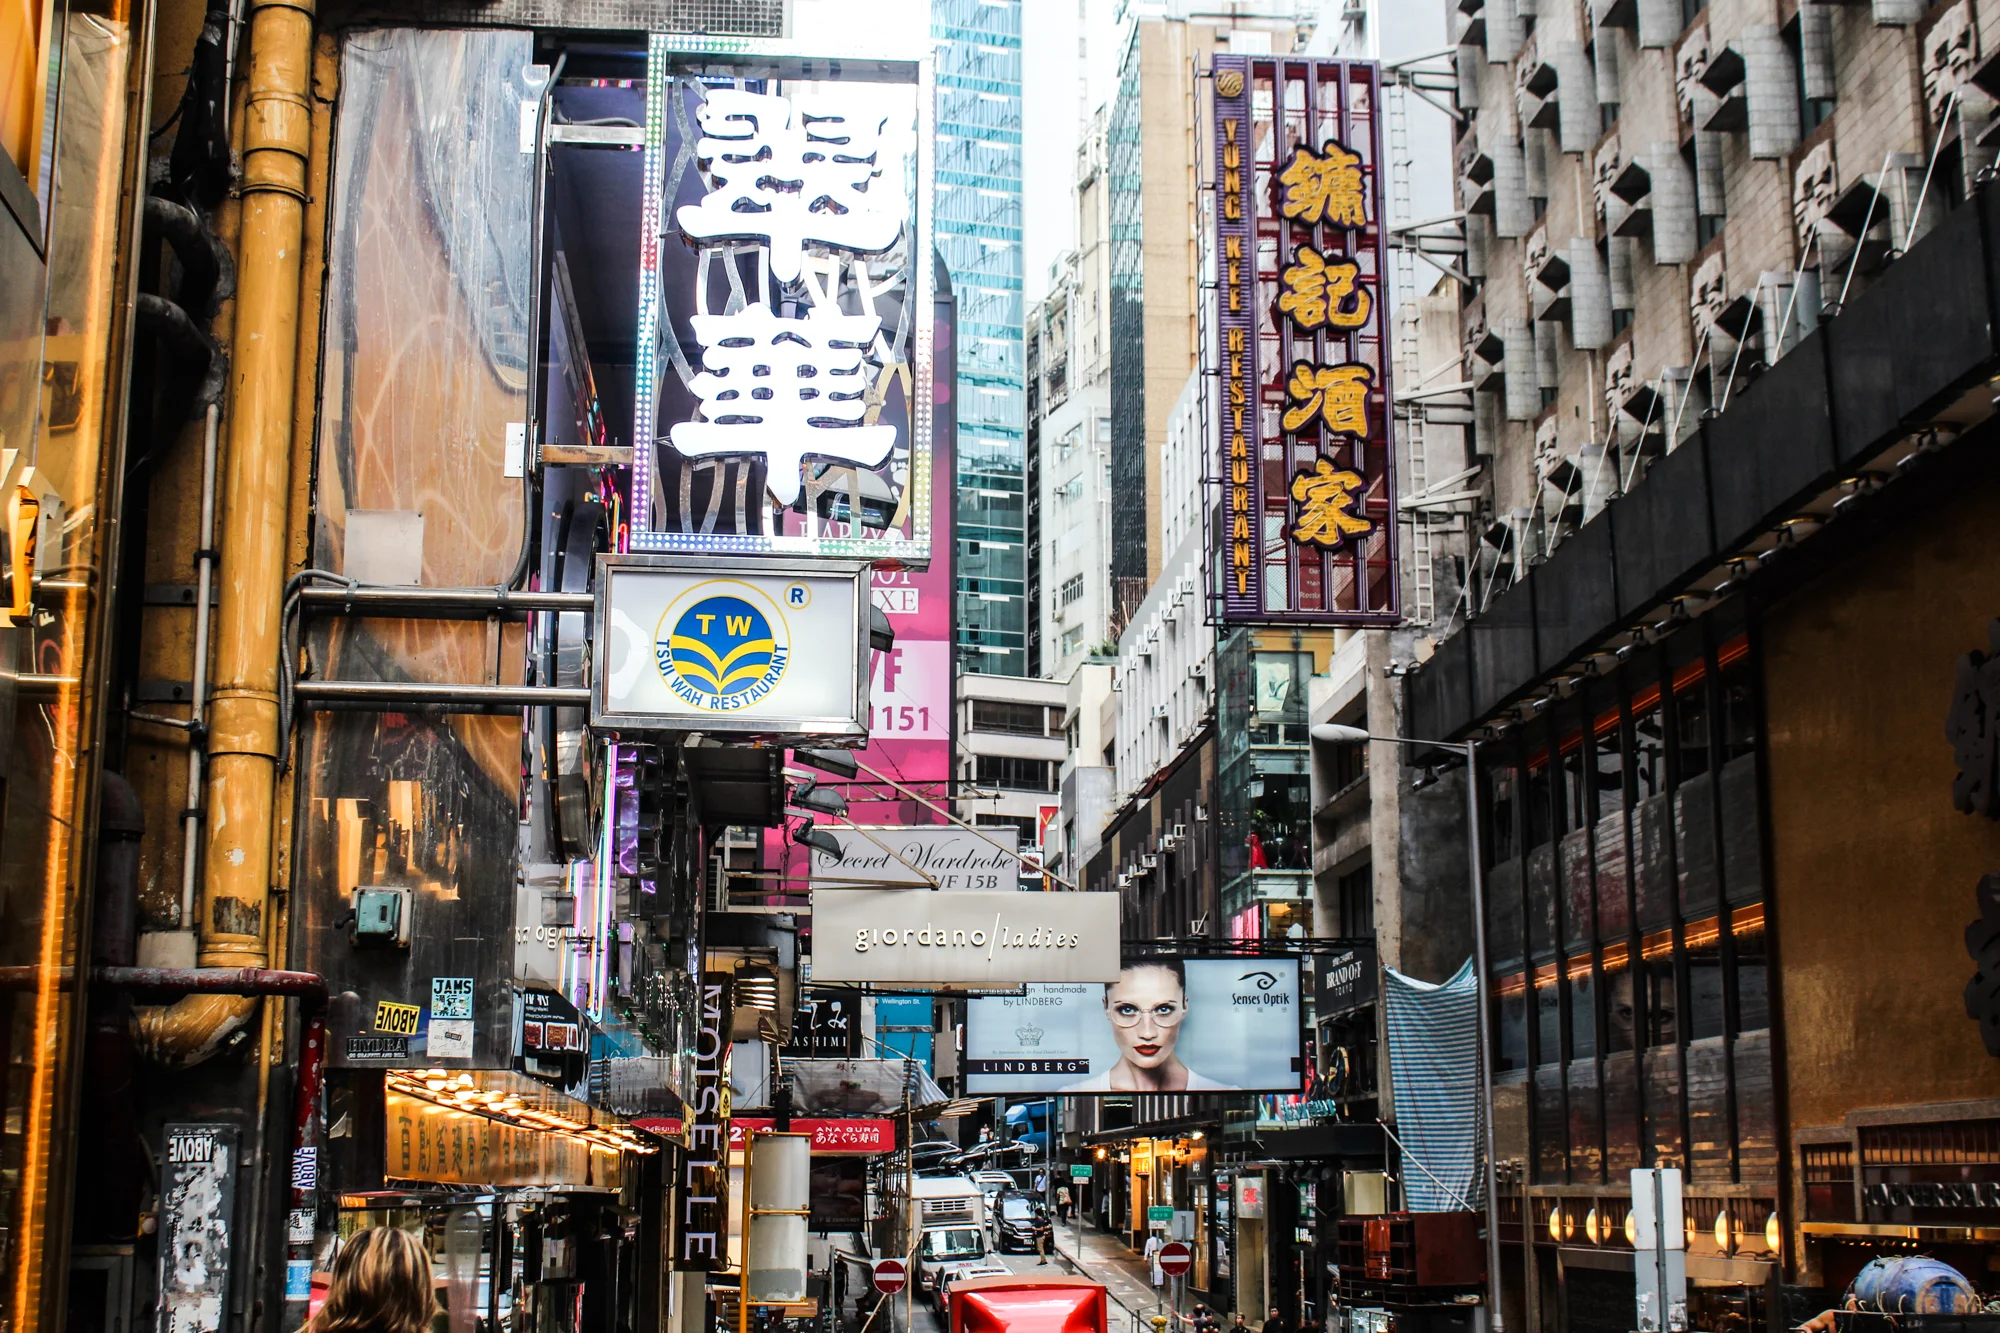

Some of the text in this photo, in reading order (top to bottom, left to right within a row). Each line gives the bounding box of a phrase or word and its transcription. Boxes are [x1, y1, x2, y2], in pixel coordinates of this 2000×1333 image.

[670, 88, 902, 508] 翠華
[1280, 141, 1372, 546] 鏞記酒家
[1223, 118, 1250, 595] YUNG KEE RESTAURANT
[656, 639, 788, 710] TSUI WAH RESTAURANT
[818, 839, 1014, 873] Secret Wardrobe
[965, 875, 998, 889] 15B
[434, 980, 472, 994] JAMS
[1044, 985, 1087, 994] handmade
[882, 998, 911, 1006] Wellington
[1003, 997, 1062, 1007] by LINDBERG
[1232, 993, 1290, 1006] Senses Optik
[375, 1006, 418, 1033] ABOVE
[348, 1038, 406, 1052] HYDRA
[785, 1036, 846, 1047] ASHIMI
[983, 1062, 1077, 1072] LINDBERG
[685, 984, 721, 1261] MOISELLE
[816, 1132, 879, 1144] あなぐら寿司
[169, 1136, 213, 1162] ABOVE
[301, 1147, 316, 1189] ABOVE
